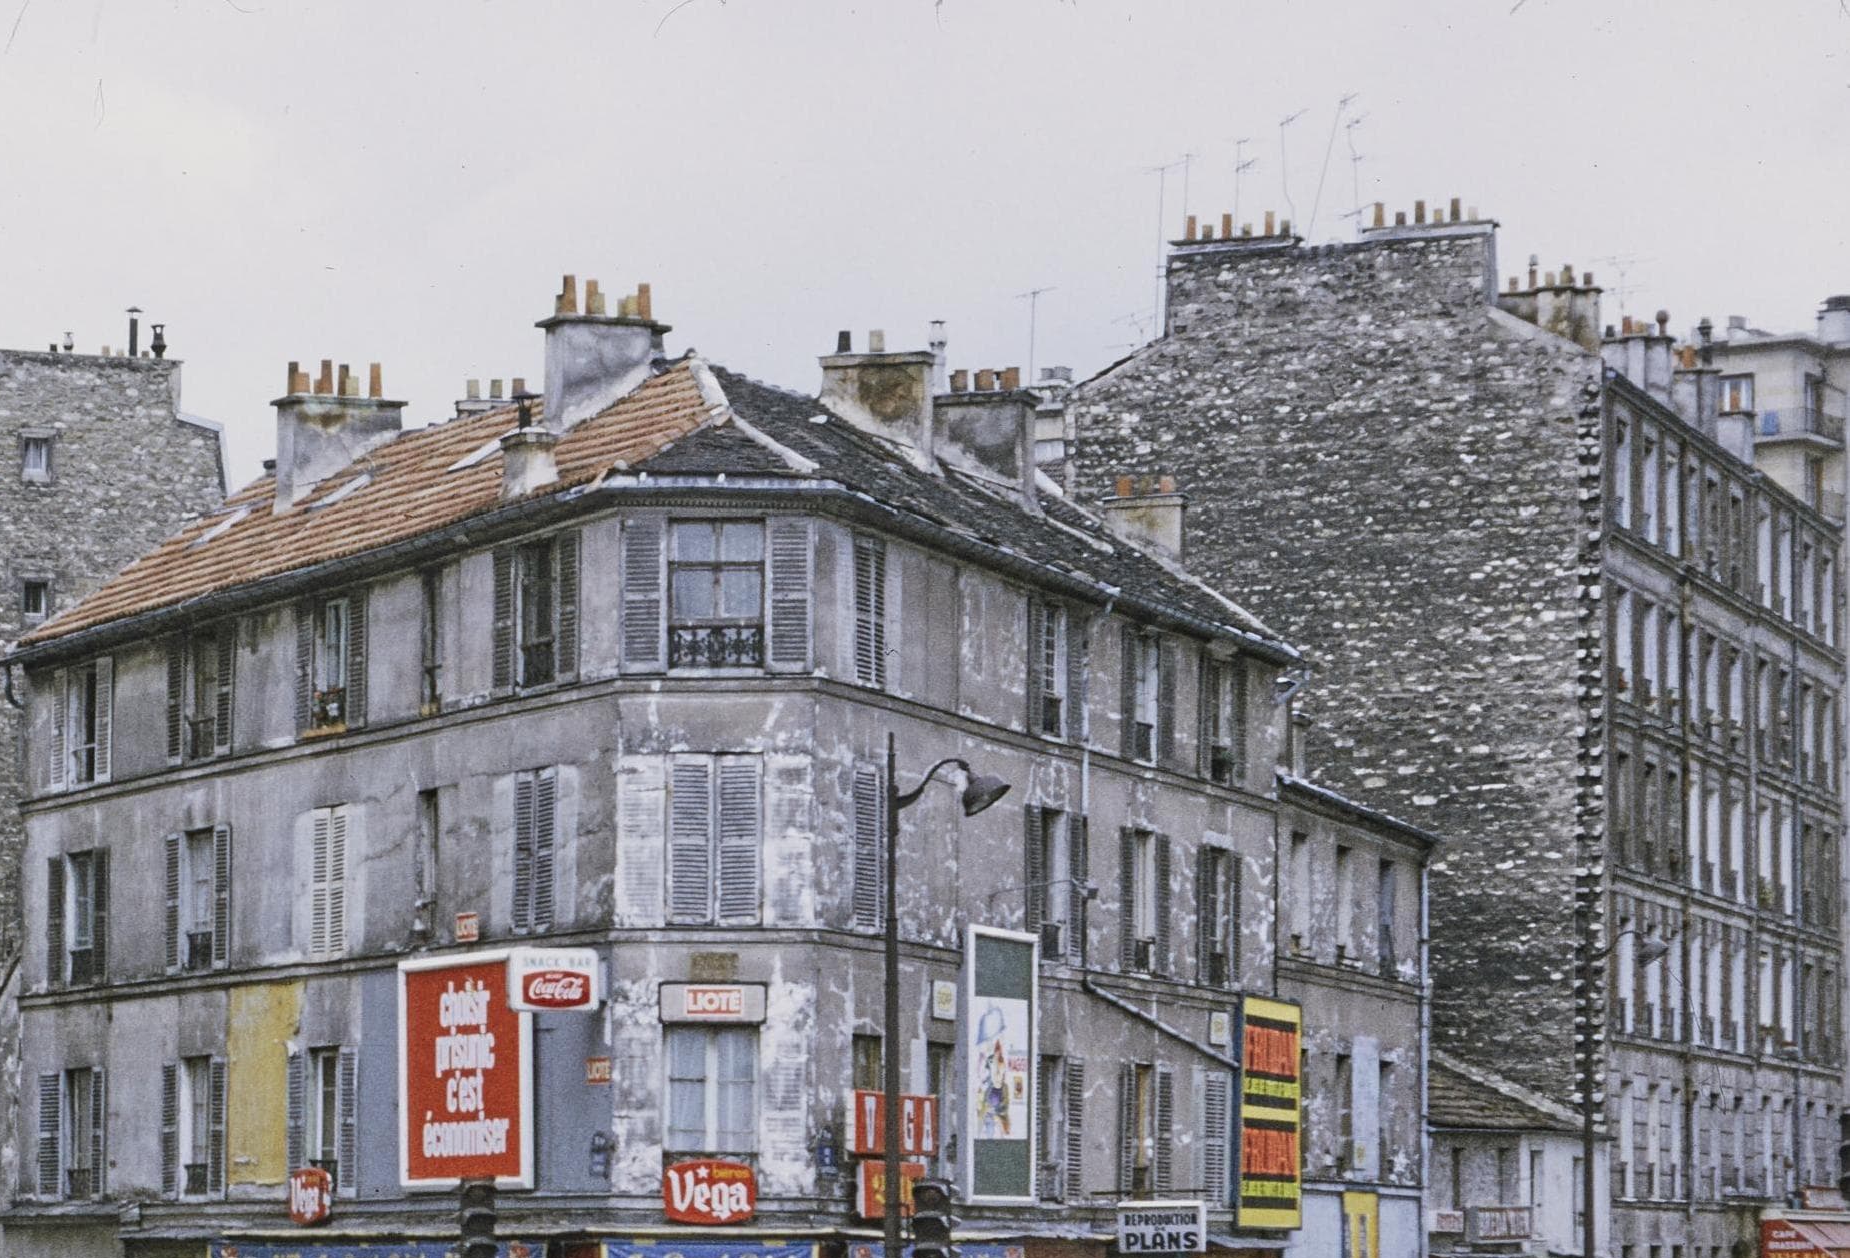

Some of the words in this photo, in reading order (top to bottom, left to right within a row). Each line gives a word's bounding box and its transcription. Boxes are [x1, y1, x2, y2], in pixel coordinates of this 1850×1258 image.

[568, 956, 592, 967] BAR
[440, 980, 491, 1027] choisir
[435, 1024, 495, 1079] prisunic
[863, 1096, 934, 1152] VGA
[1124, 1212, 1198, 1226] REPRODUCTION
[1124, 1231, 1199, 1251] PLANS
